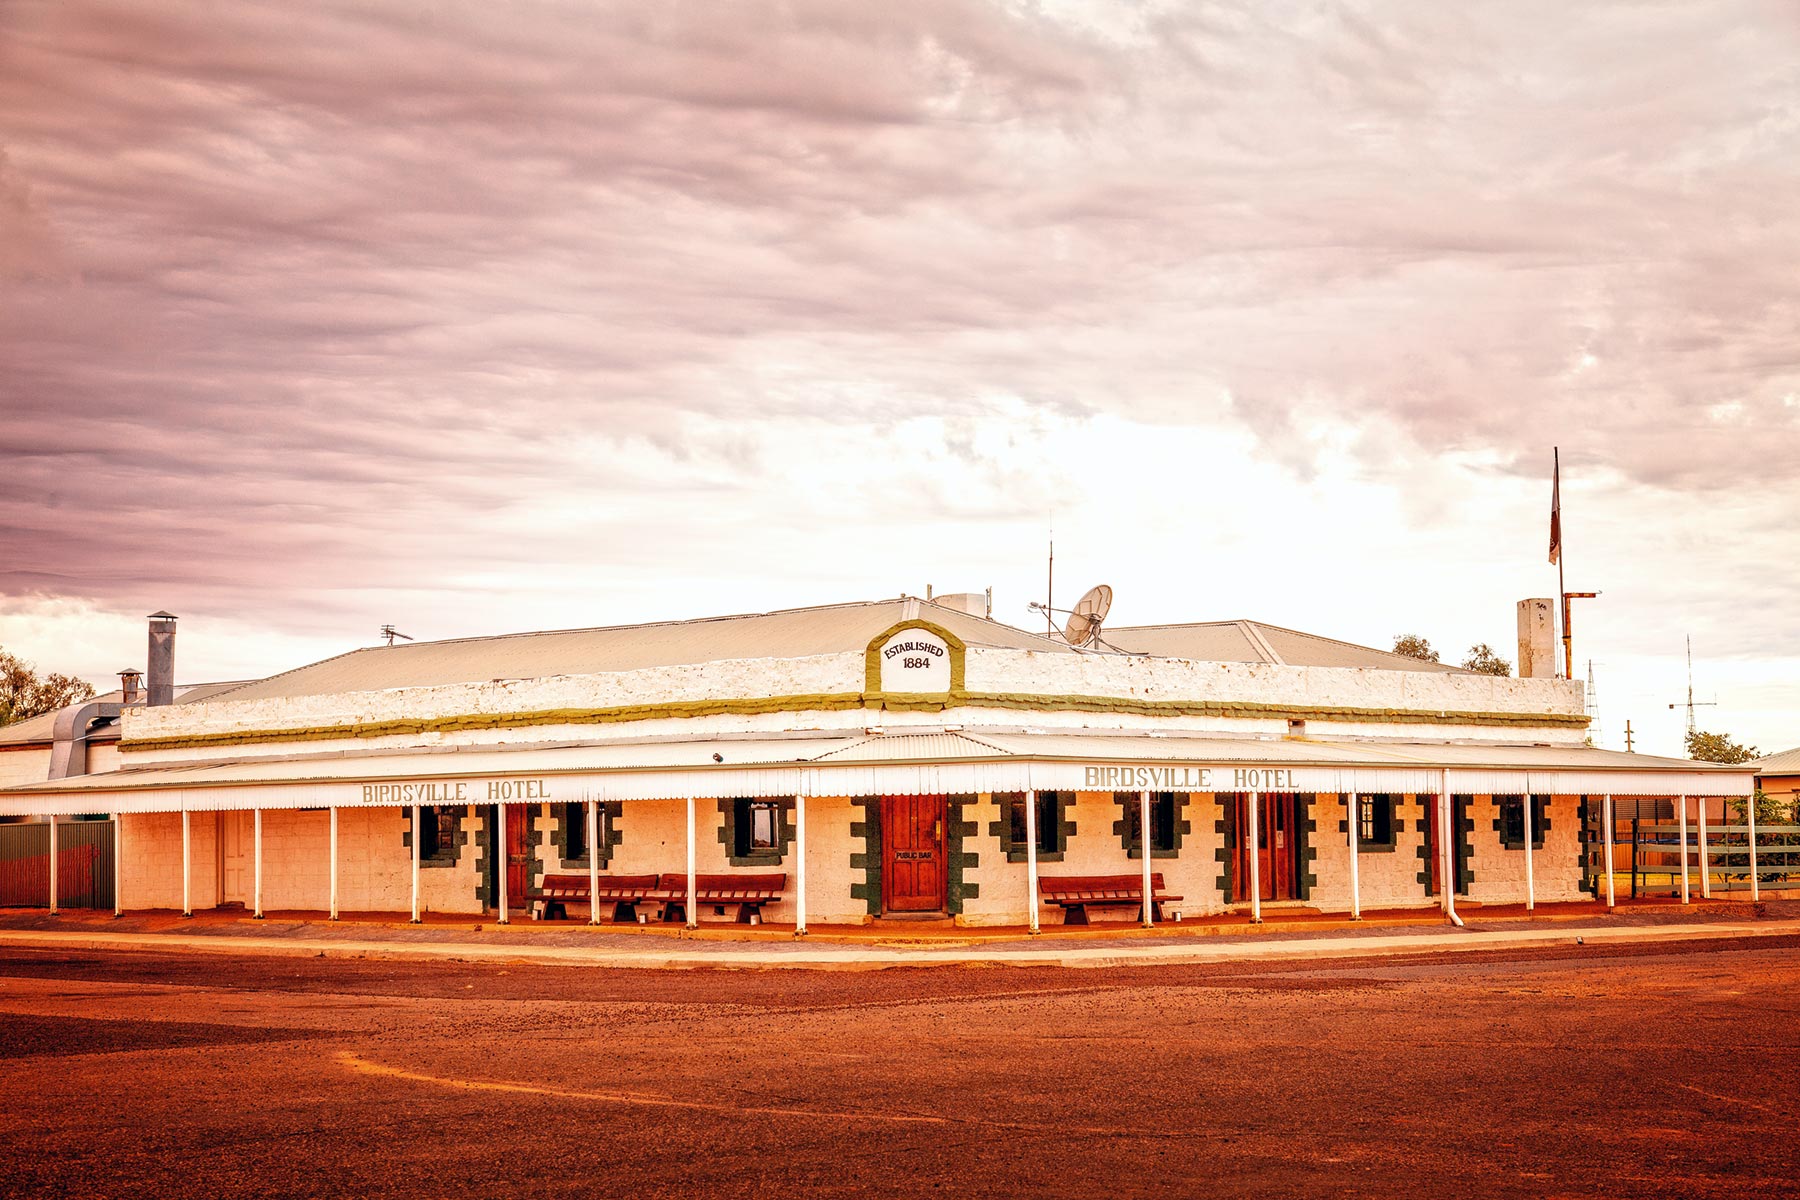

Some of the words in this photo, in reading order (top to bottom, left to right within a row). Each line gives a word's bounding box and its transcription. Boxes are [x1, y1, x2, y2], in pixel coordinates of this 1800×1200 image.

[884, 641, 944, 660] ESTABLISHED
[903, 657, 930, 668] 1884
[1085, 766, 1212, 787] BIRDSVILLE
[1234, 769, 1300, 788] HOTEL
[362, 783, 467, 803] BIRDSVILLE
[488, 780, 551, 800] HOTEL
